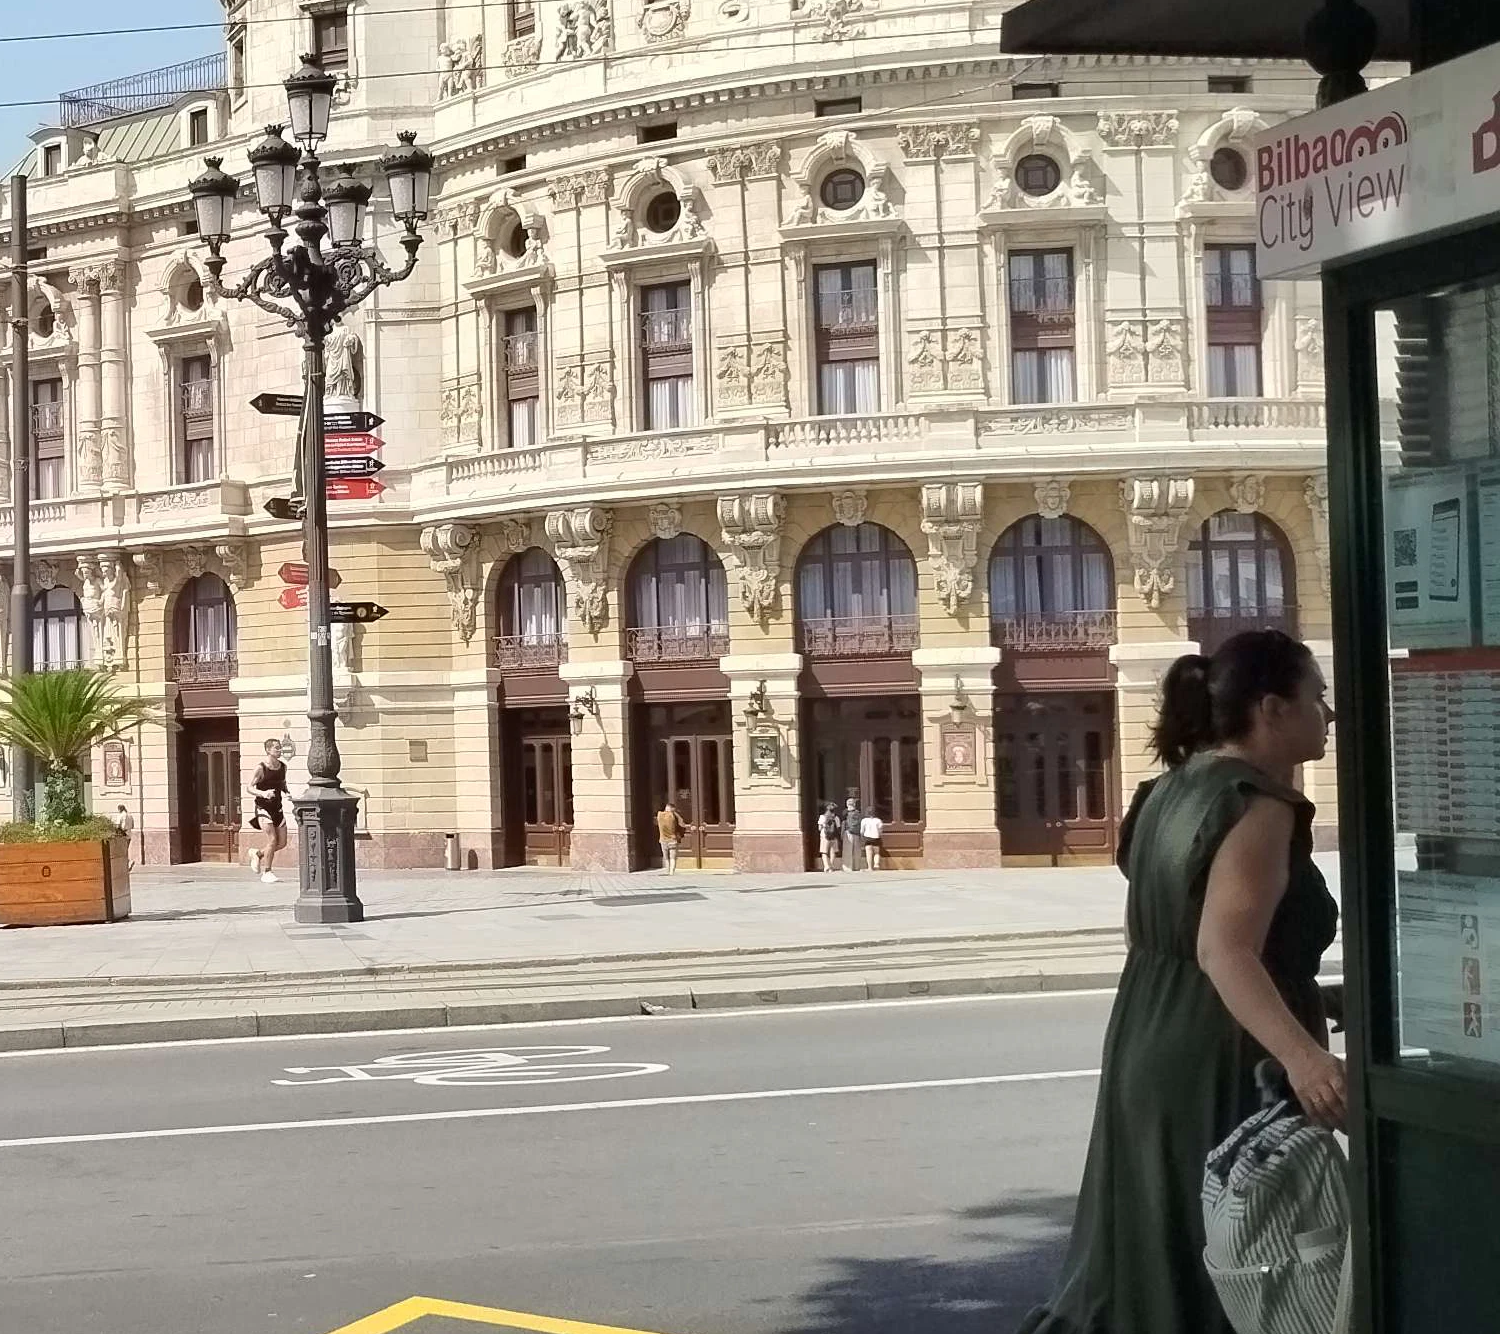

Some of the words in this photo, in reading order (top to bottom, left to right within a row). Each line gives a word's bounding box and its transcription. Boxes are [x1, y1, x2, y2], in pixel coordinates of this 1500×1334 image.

[1257, 128, 1346, 193] Bilbao
[1260, 192, 1313, 252] City
[1324, 164, 1405, 228] View
